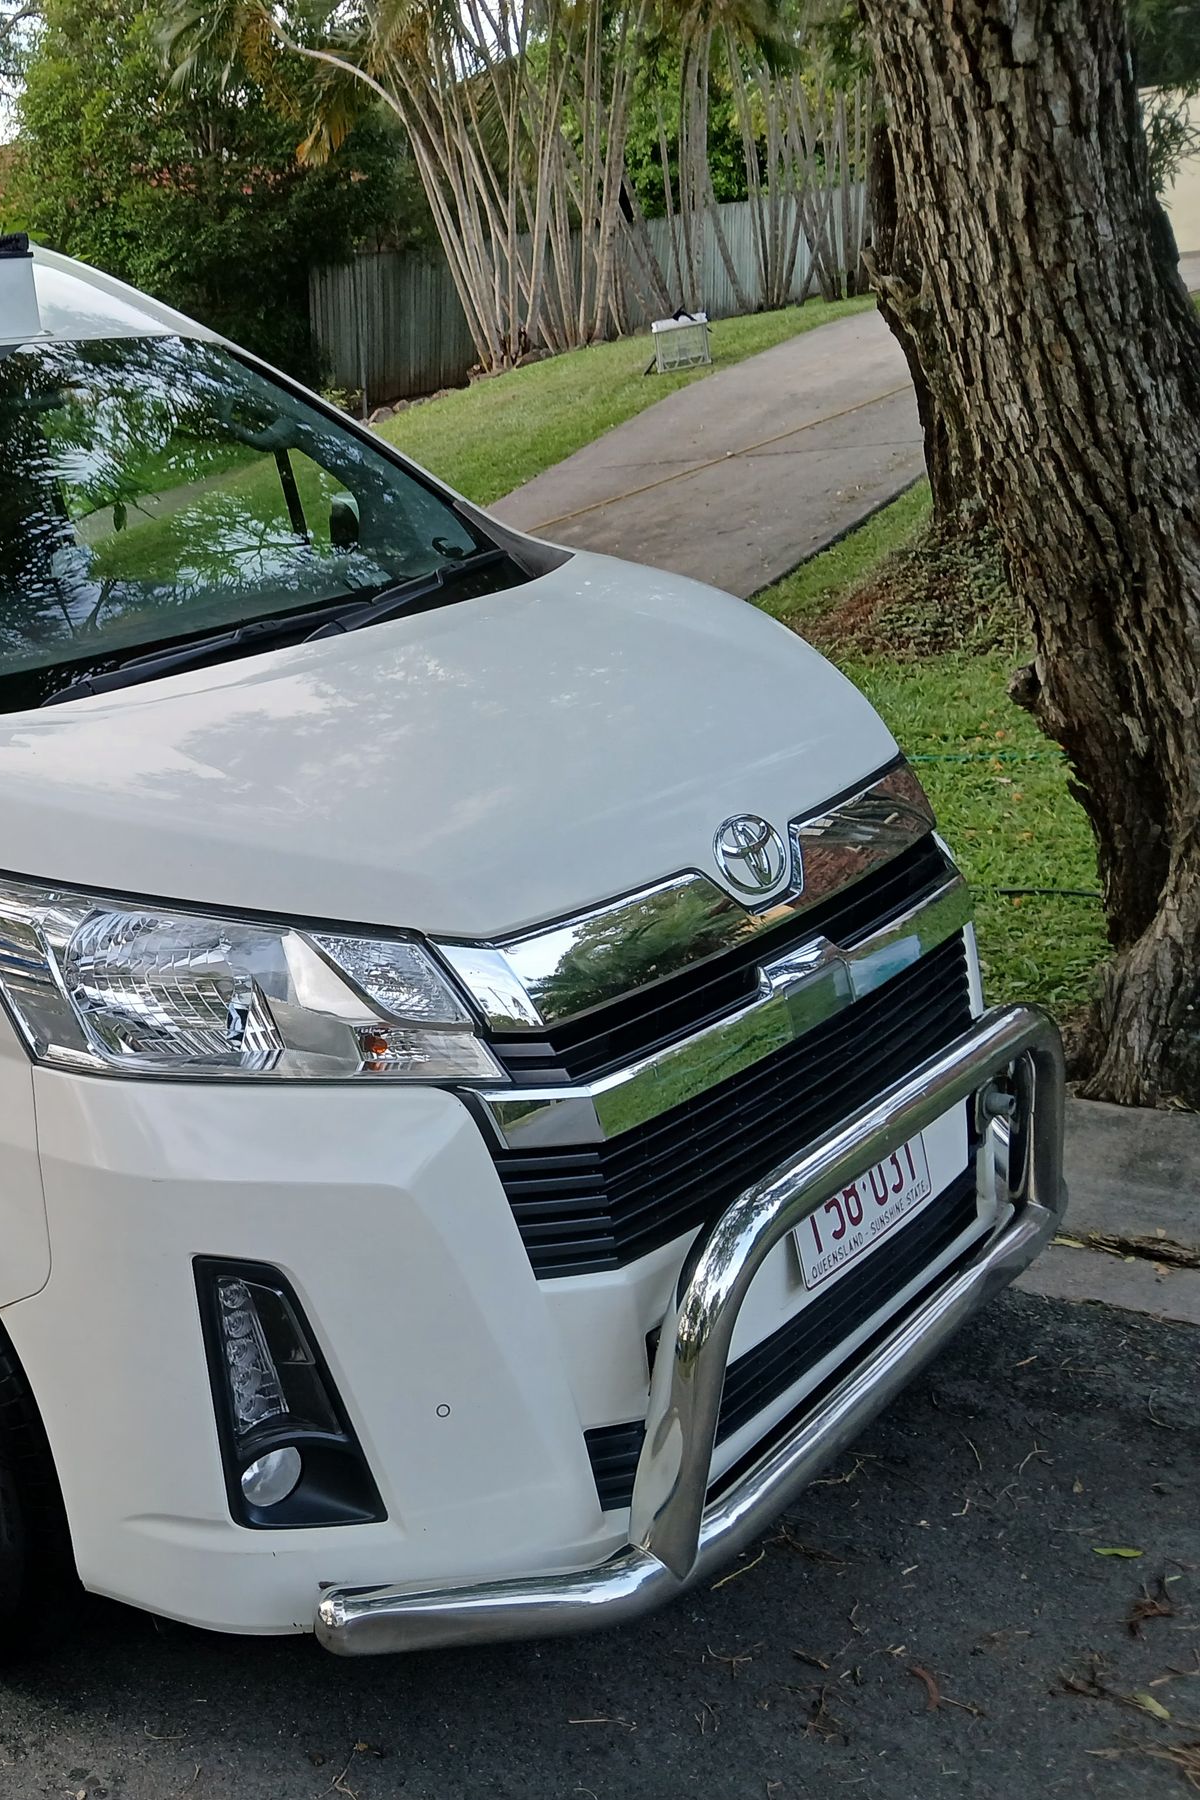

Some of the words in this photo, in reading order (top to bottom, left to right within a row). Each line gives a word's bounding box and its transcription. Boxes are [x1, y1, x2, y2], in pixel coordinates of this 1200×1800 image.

[811, 1231, 864, 1280] QUEENSLAND
[870, 1201, 905, 1236] SUNSHINE
[906, 1180, 927, 1206] STATE
